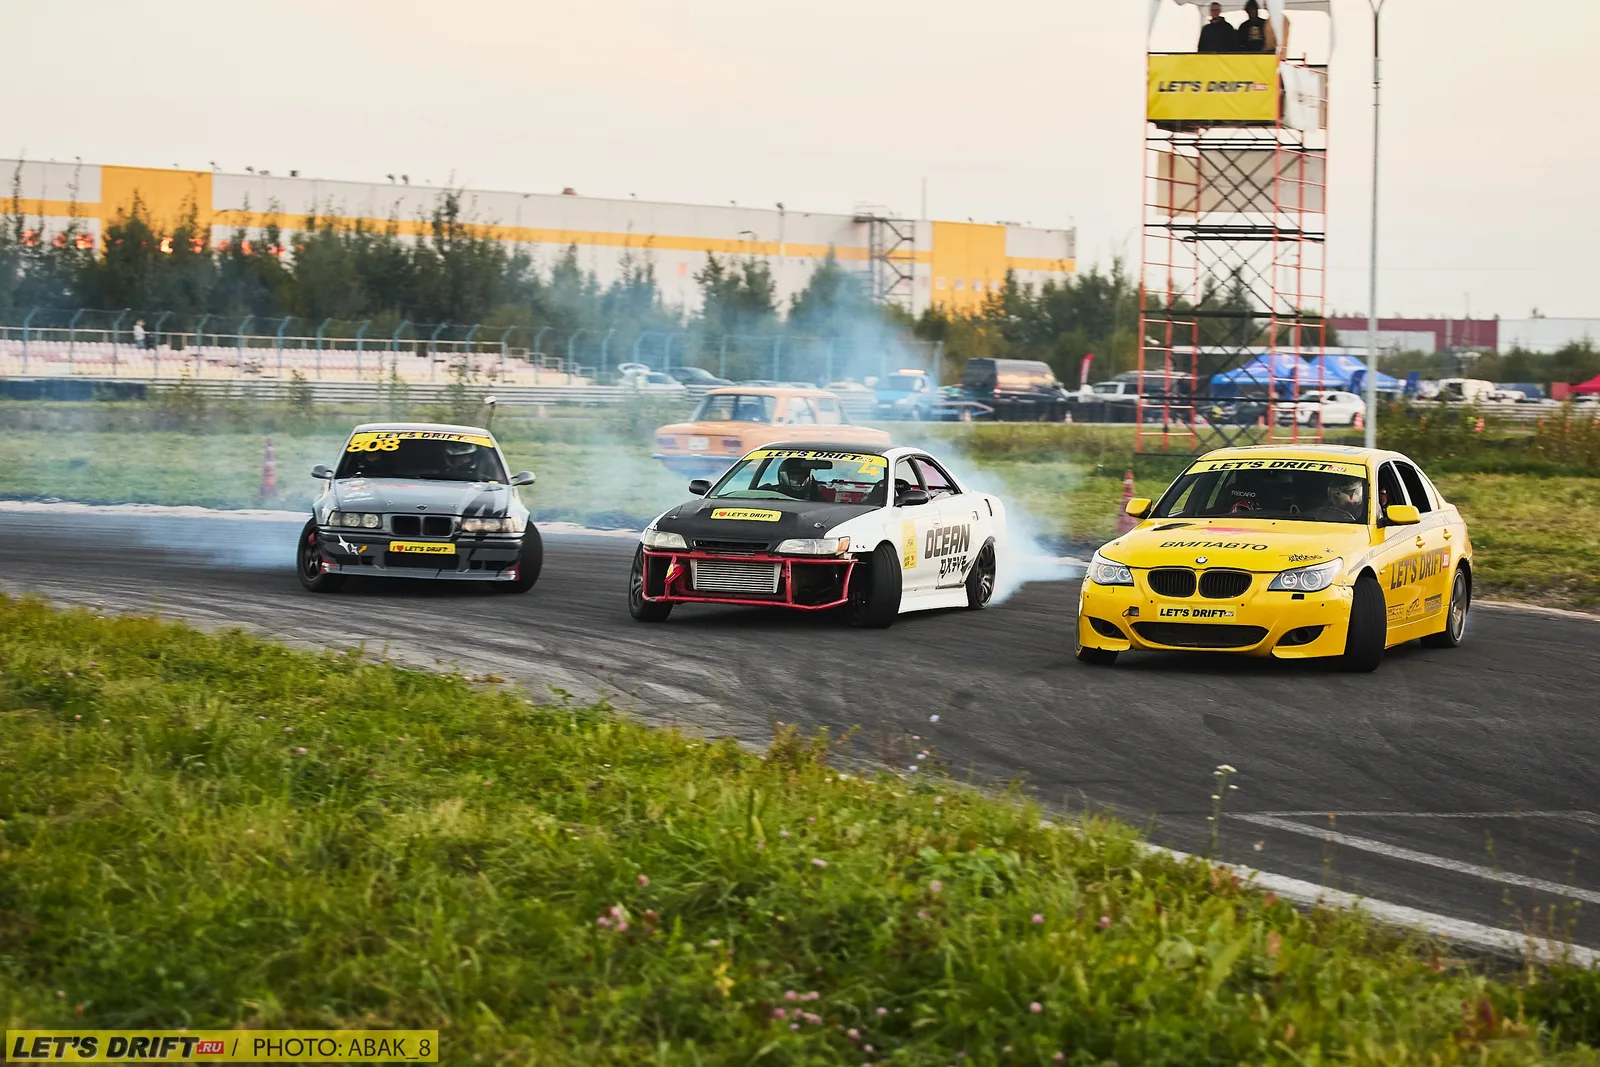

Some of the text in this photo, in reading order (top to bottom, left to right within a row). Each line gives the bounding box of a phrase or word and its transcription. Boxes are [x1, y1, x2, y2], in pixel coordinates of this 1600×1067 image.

[1157, 80, 1202, 92] LET'S
[376, 431, 416, 440] LET'S
[346, 438, 401, 453] 808
[765, 450, 810, 458] LET'S
[1207, 460, 1265, 471] LET'S
[1231, 489, 1256, 498] RECARO
[924, 523, 971, 560] OCEAN
[1159, 541, 1268, 551] ВМПАВТО
[1390, 557, 1418, 590] LET'S
[1159, 608, 1190, 617] LET'S
